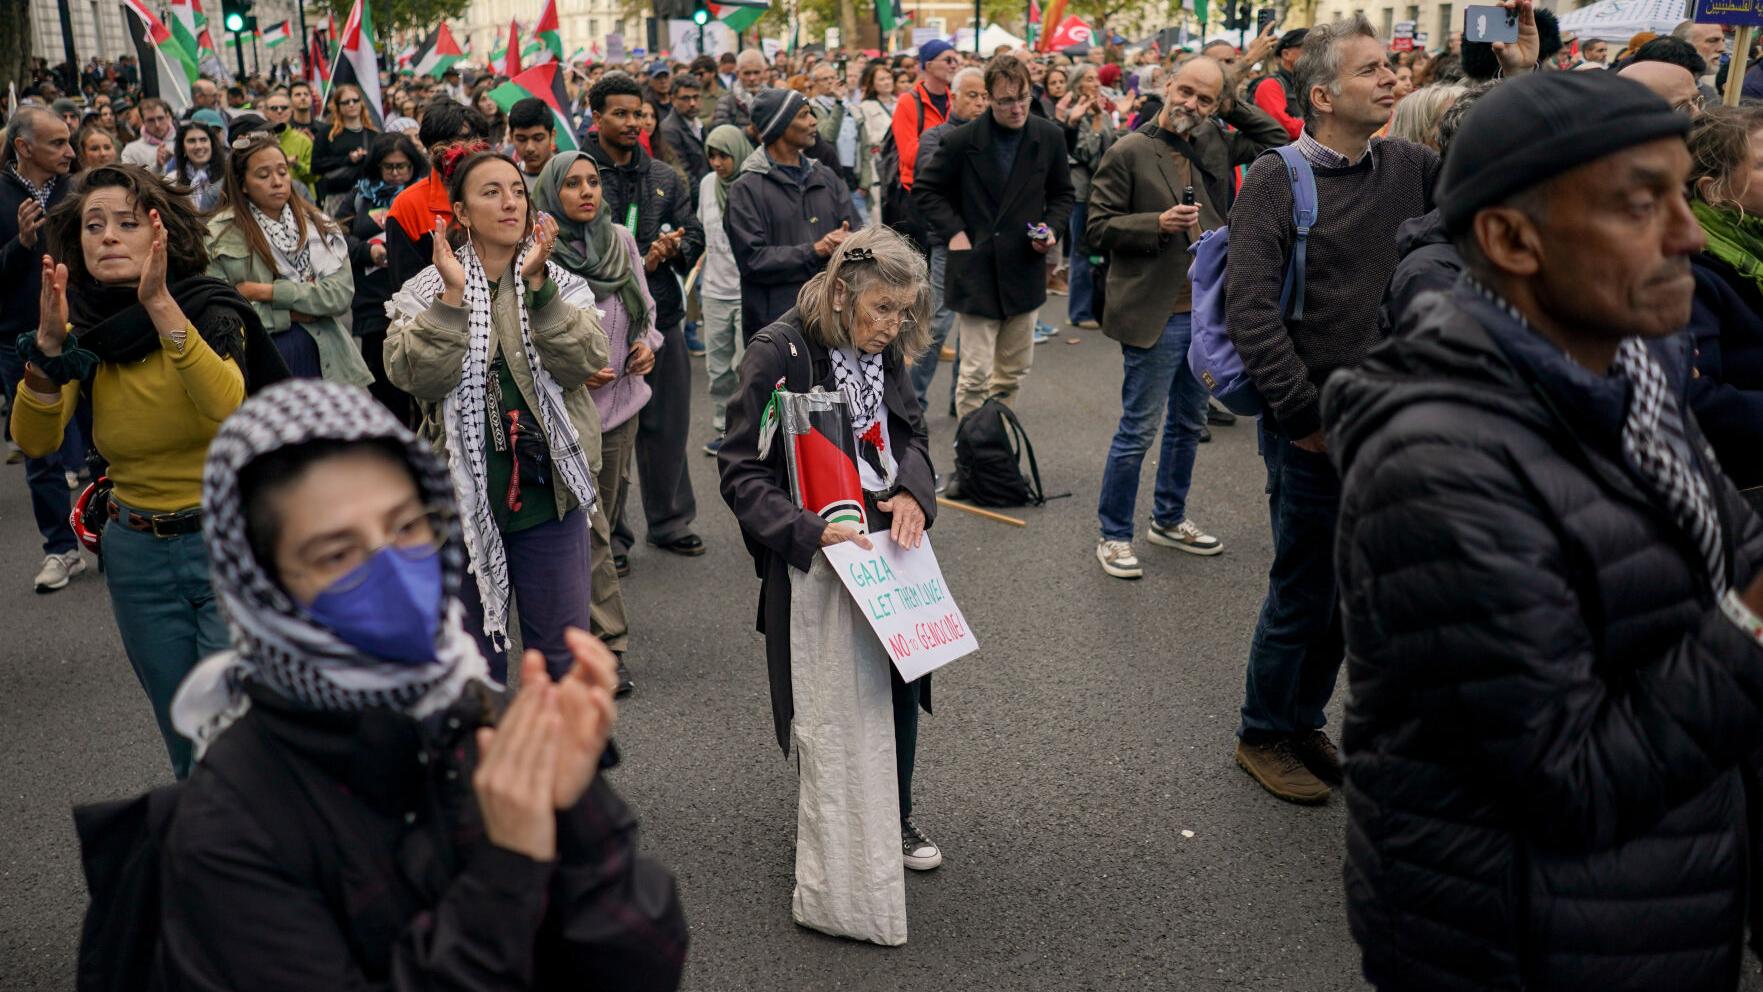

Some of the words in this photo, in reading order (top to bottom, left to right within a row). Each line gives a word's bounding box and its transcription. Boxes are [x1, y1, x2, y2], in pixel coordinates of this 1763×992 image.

[849, 555, 896, 588] GAZA
[868, 592, 896, 620] LET
[894, 584, 922, 610] THEM
[917, 578, 945, 606] LIVE!
[888, 633, 911, 660] NO
[915, 612, 966, 650] GENOCIDE!
